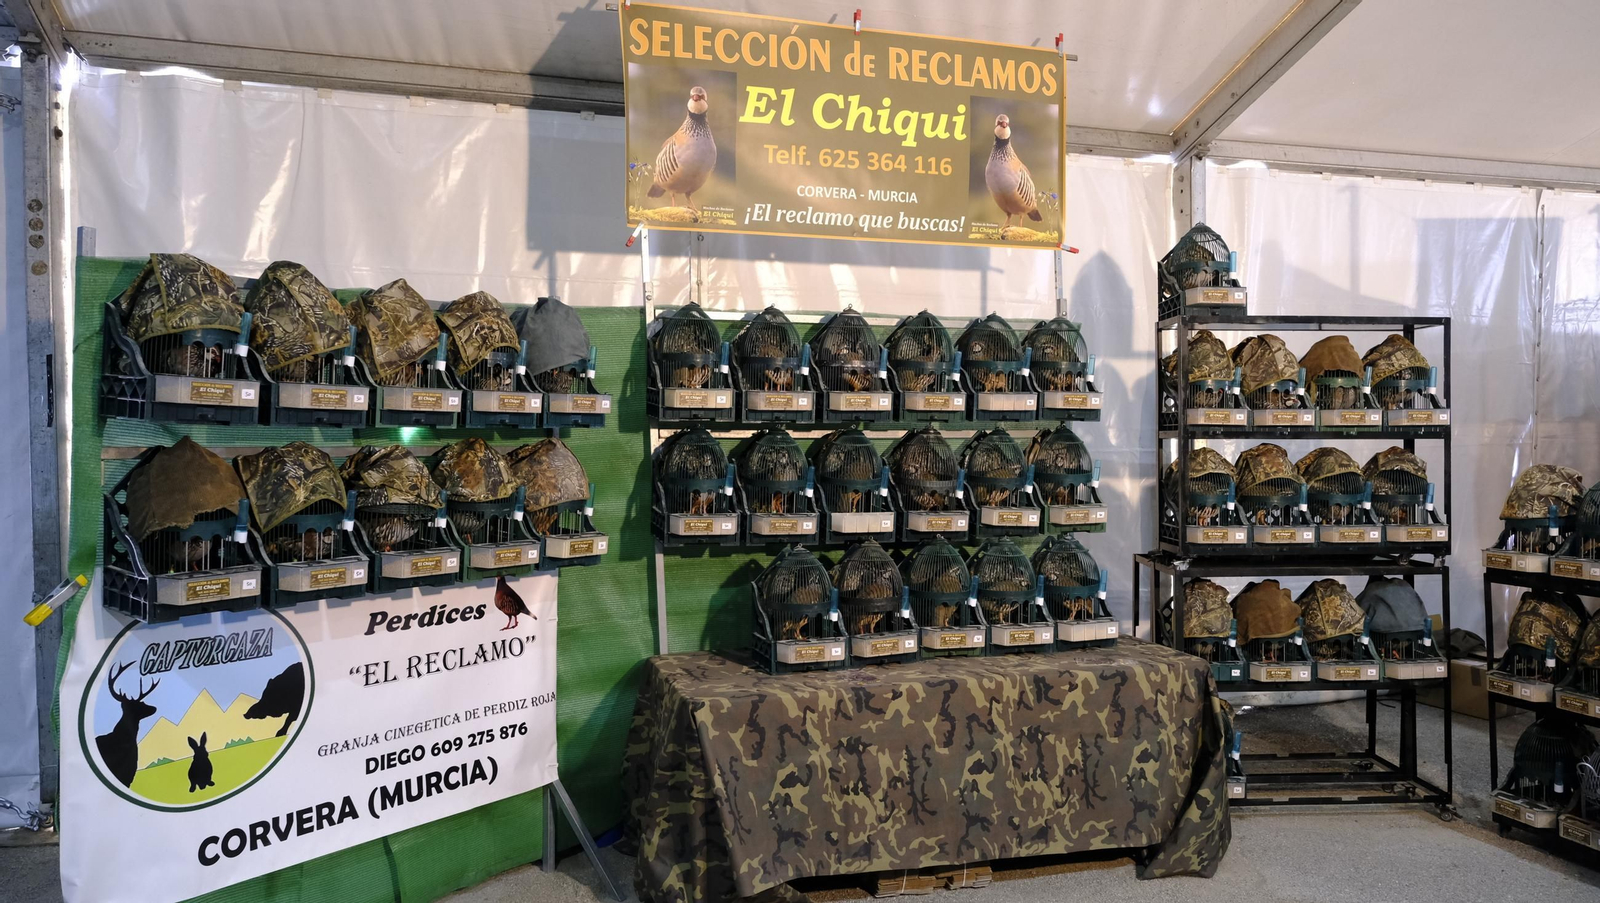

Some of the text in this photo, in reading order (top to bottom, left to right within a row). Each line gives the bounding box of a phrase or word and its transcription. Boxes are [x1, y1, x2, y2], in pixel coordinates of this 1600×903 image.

[629, 18, 831, 73] SELECCIÓN
[888, 46, 1058, 97] RECLAMOS
[738, 85, 968, 147] El Chiqui
[763, 144, 953, 176] Telf. 625 364 116
[712, 211, 734, 219] Chiqui
[796, 184, 857, 200] CORVERA
[868, 189, 918, 204] MURCIA
[744, 203, 966, 233] ¡El reclamo que buscas!
[364, 603, 487, 635] Perdices
[317, 691, 556, 758] GRANJA CINEGETICA DE PERDIZ ROJA
[365, 721, 528, 775] DIEGO 609 275 876
[197, 755, 499, 867] CORVERA (MURCIA)
